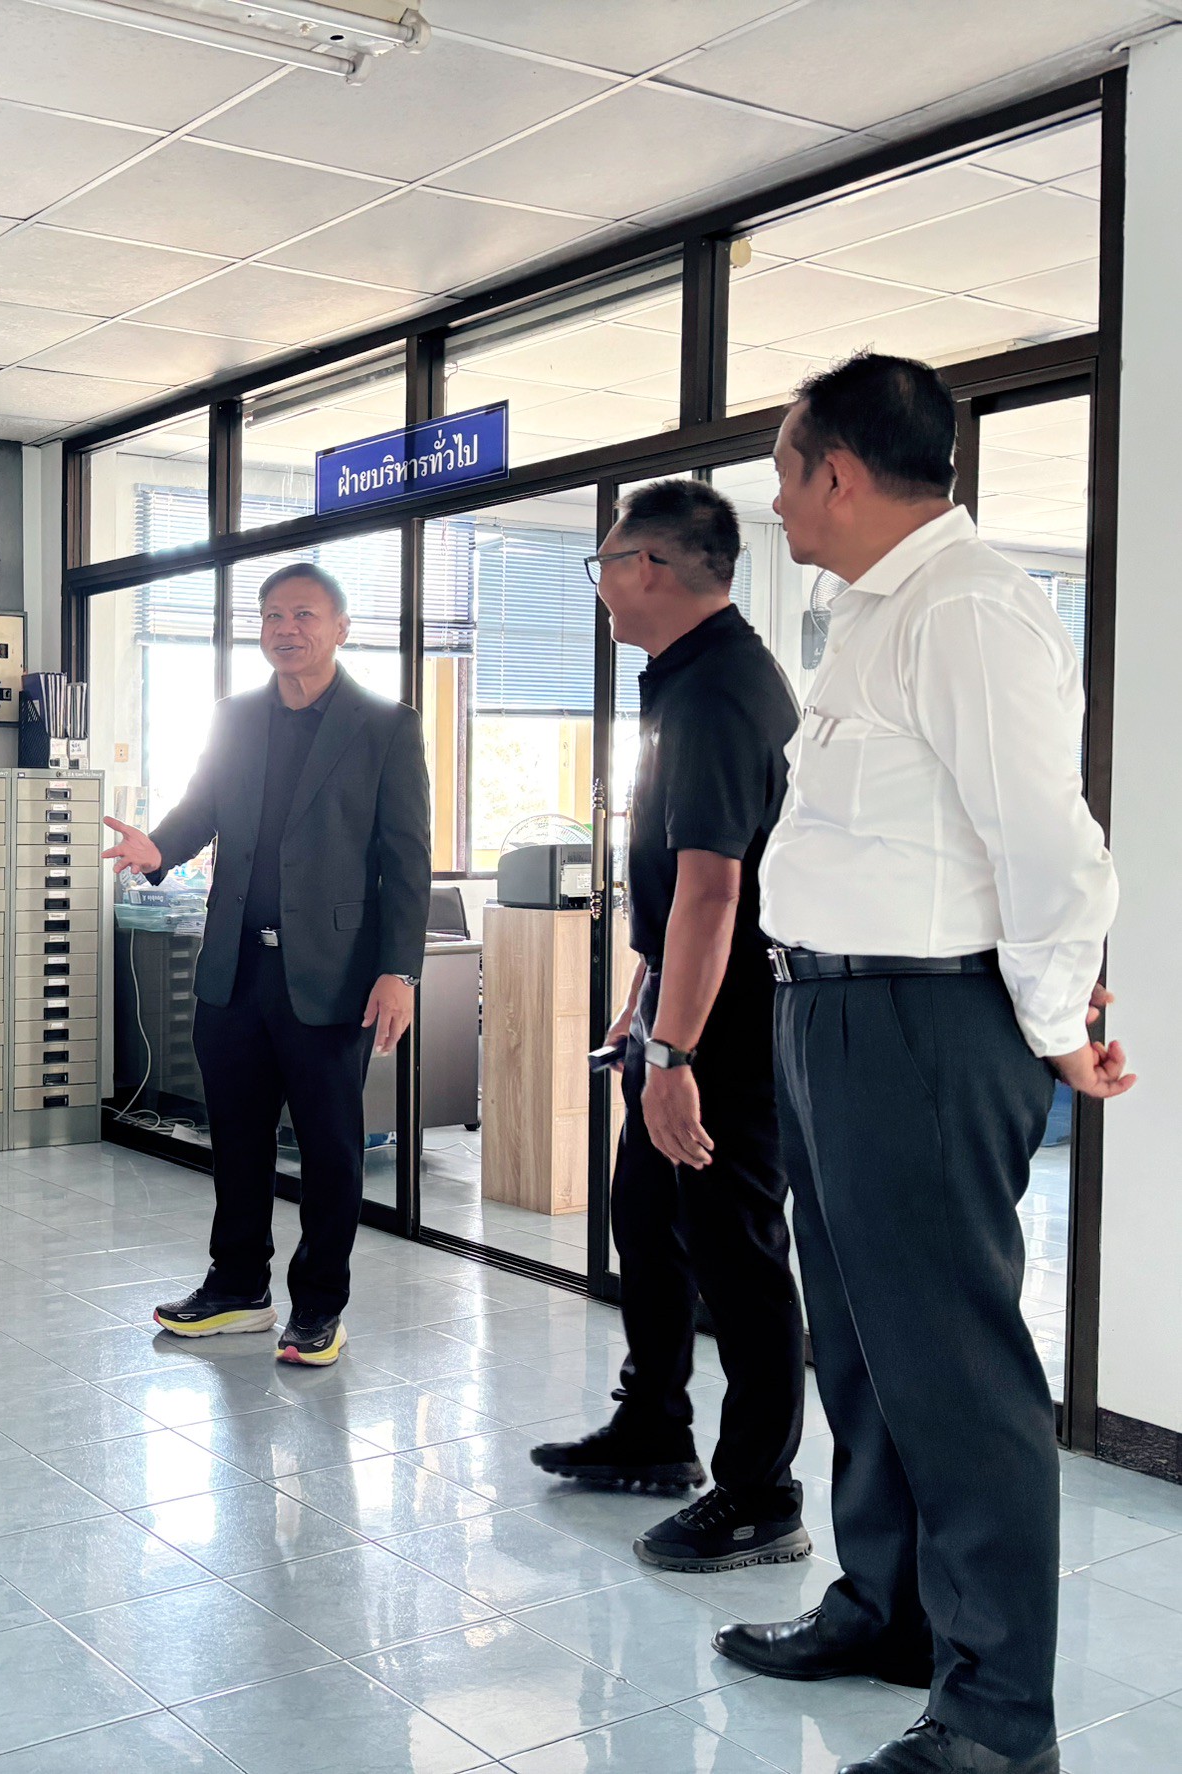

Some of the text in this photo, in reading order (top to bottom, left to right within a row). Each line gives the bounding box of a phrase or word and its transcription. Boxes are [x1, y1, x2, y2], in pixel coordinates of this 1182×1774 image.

[337, 429, 479, 498] ฝ่ายบริหารทั่วไป
